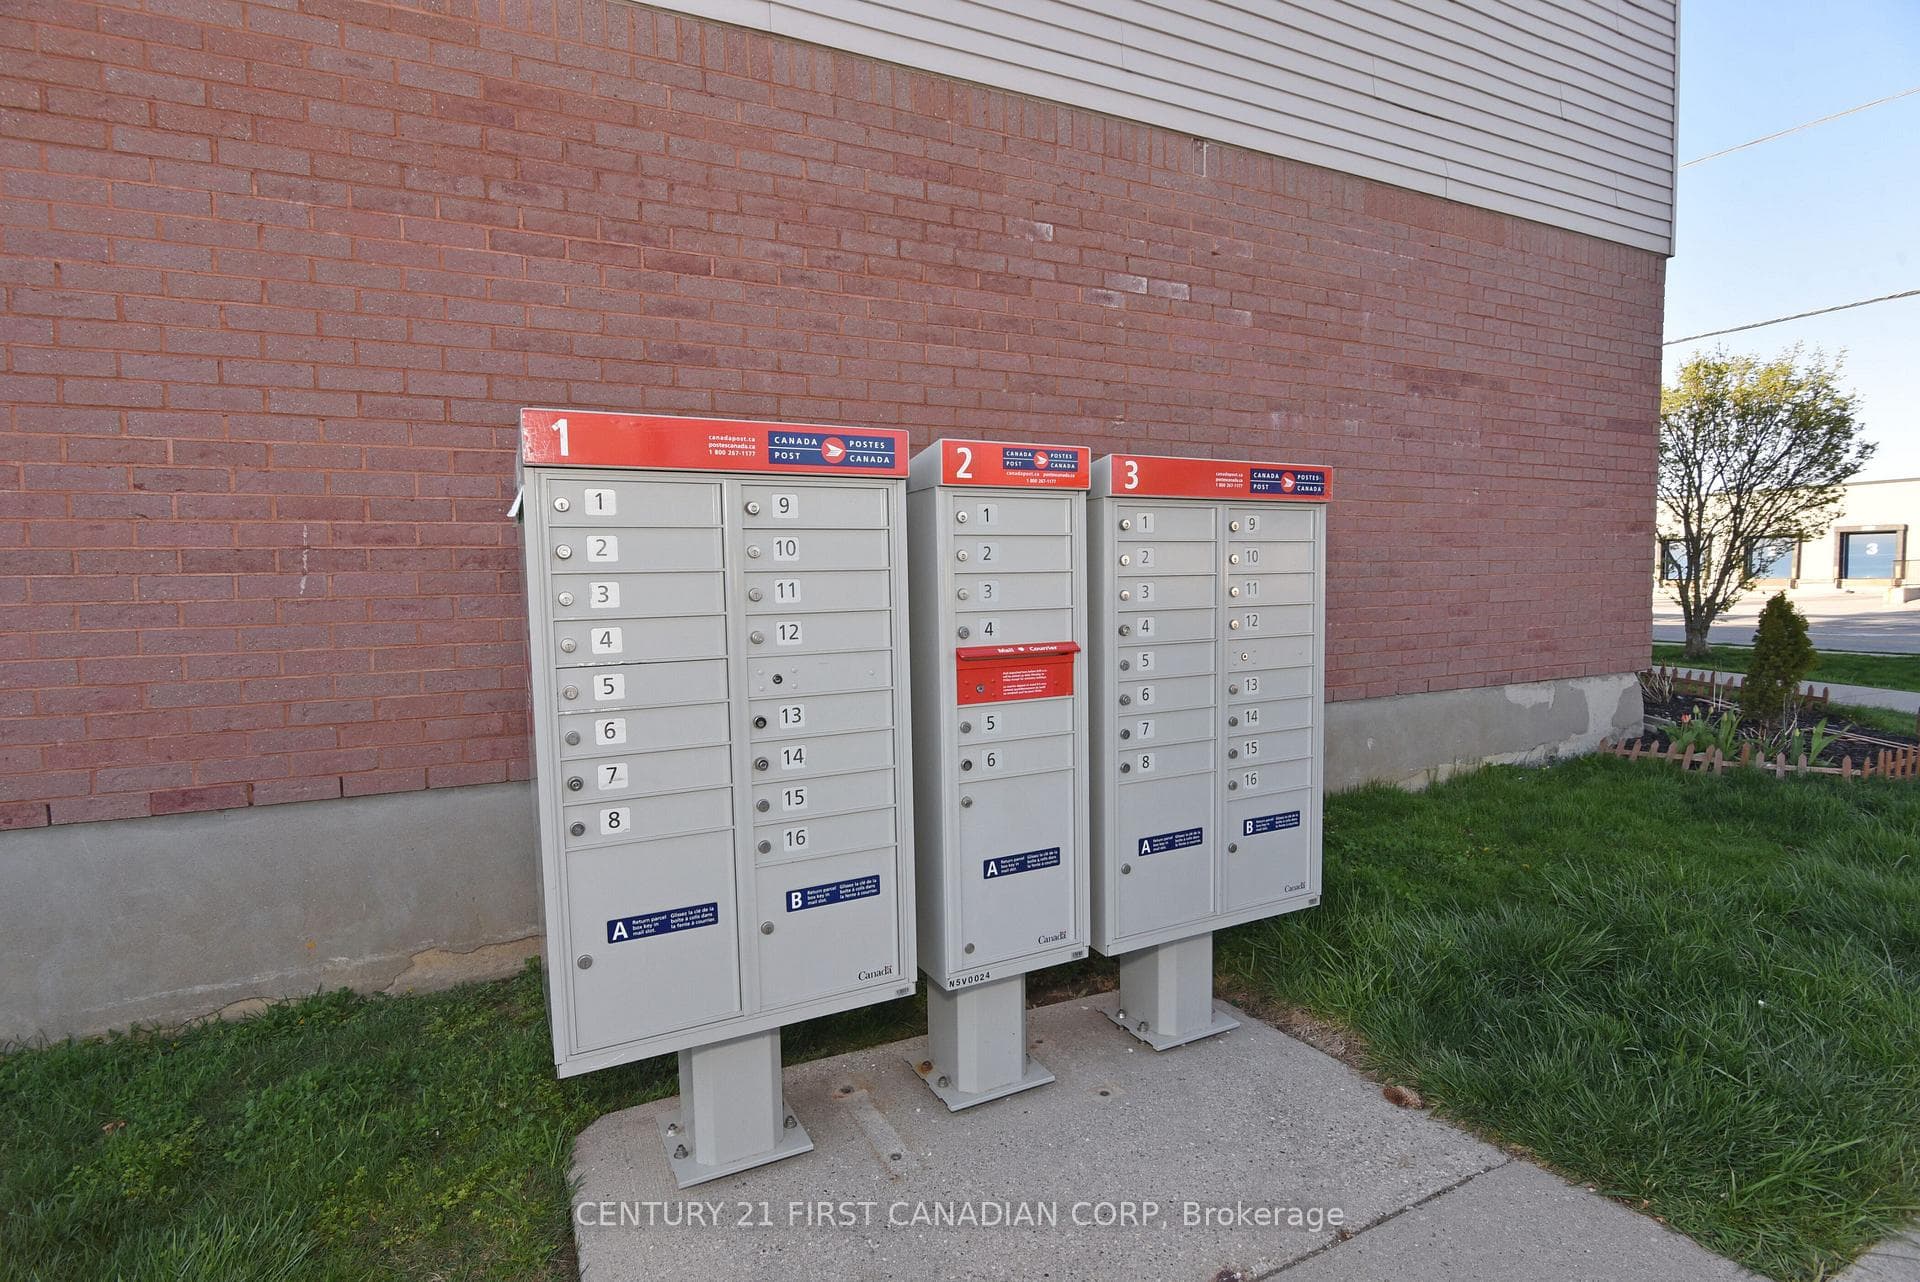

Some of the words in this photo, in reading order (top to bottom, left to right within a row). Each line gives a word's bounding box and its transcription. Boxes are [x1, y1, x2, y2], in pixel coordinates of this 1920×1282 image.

[551, 418, 569, 456] 1
[774, 436, 818, 446] CANADA
[850, 440, 885, 449] POSTES
[774, 452, 800, 460] POST
[850, 455, 890, 463] CANADA
[956, 447, 972, 479] 2
[1124, 460, 1138, 489] 3
[595, 492, 603, 510] 1
[779, 497, 790, 514] 9
[1142, 515, 1147, 529] 1
[1248, 517, 1256, 531] 9
[595, 538, 608, 557] 2
[775, 539, 797, 557] 10
[983, 545, 992, 561] 2
[1866, 542, 1879, 555] 3
[1141, 550, 1149, 564] 2
[1246, 549, 1259, 563] 10
[597, 585, 609, 603] 3
[777, 582, 795, 599] 11
[984, 584, 992, 599] 3
[1142, 584, 1149, 599] 3
[1246, 582, 1257, 595] 11
[1141, 619, 1150, 633] 4
[1246, 614, 1258, 627] 12
[779, 623, 799, 641] 12
[984, 621, 994, 636] 4
[599, 630, 613, 648] 4
[1142, 653, 1149, 667] 5
[603, 677, 615, 695] 5
[1246, 678, 1258, 691] 13
[1142, 687, 1150, 701] 6
[782, 707, 802, 724] 13
[987, 715, 995, 731] 5
[1246, 710, 1258, 723] 14
[604, 721, 616, 739] 6
[1142, 722, 1150, 736] 7
[1245, 741, 1258, 755] 15
[783, 748, 804, 765] 14
[987, 752, 996, 767] 6
[1142, 755, 1150, 769] 8
[606, 766, 618, 784] 7
[1245, 772, 1257, 786] 16
[784, 789, 805, 806] 15
[608, 811, 621, 829] 8
[1246, 821, 1253, 834] B
[786, 829, 806, 847] 16
[1141, 840, 1151, 854] A
[987, 861, 998, 877] A
[791, 892, 802, 909] B
[612, 922, 629, 940] A
[858, 966, 892, 980] Canada
[949, 971, 990, 987] N5V0024
